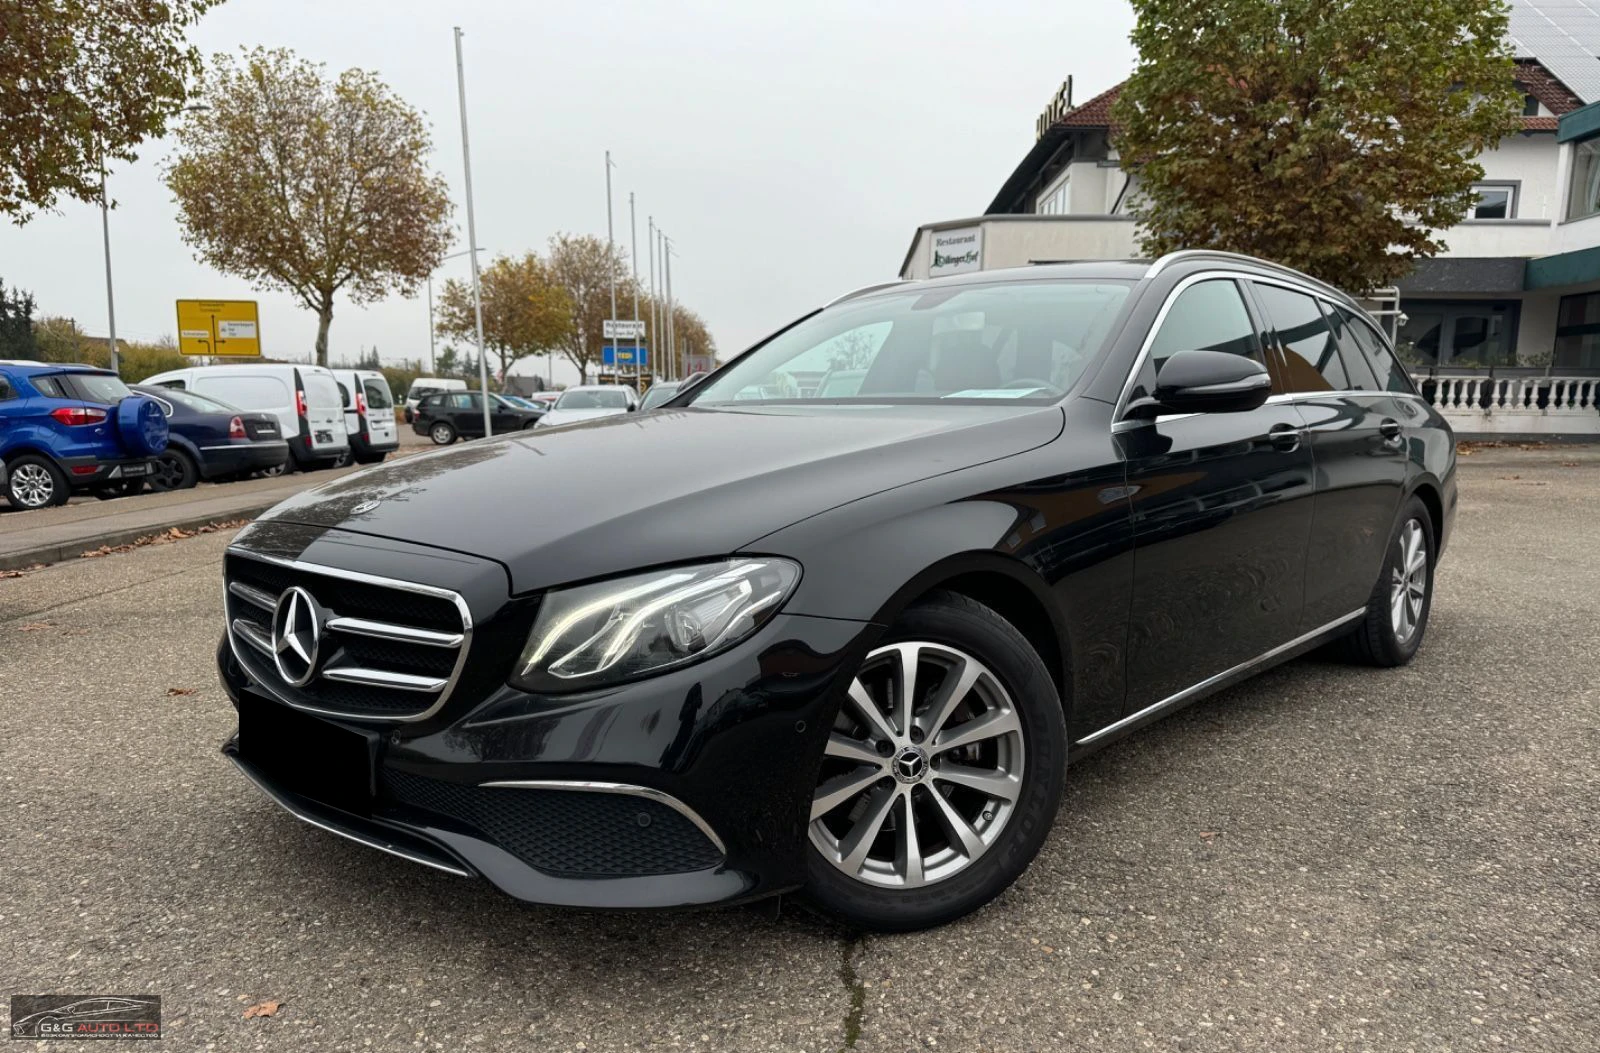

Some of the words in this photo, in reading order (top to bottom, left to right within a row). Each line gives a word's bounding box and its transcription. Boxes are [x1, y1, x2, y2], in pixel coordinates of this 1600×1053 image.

[1035, 74, 1073, 141] HOTEL
[936, 234, 976, 247] Restaurant
[965, 250, 979, 264] Hof
